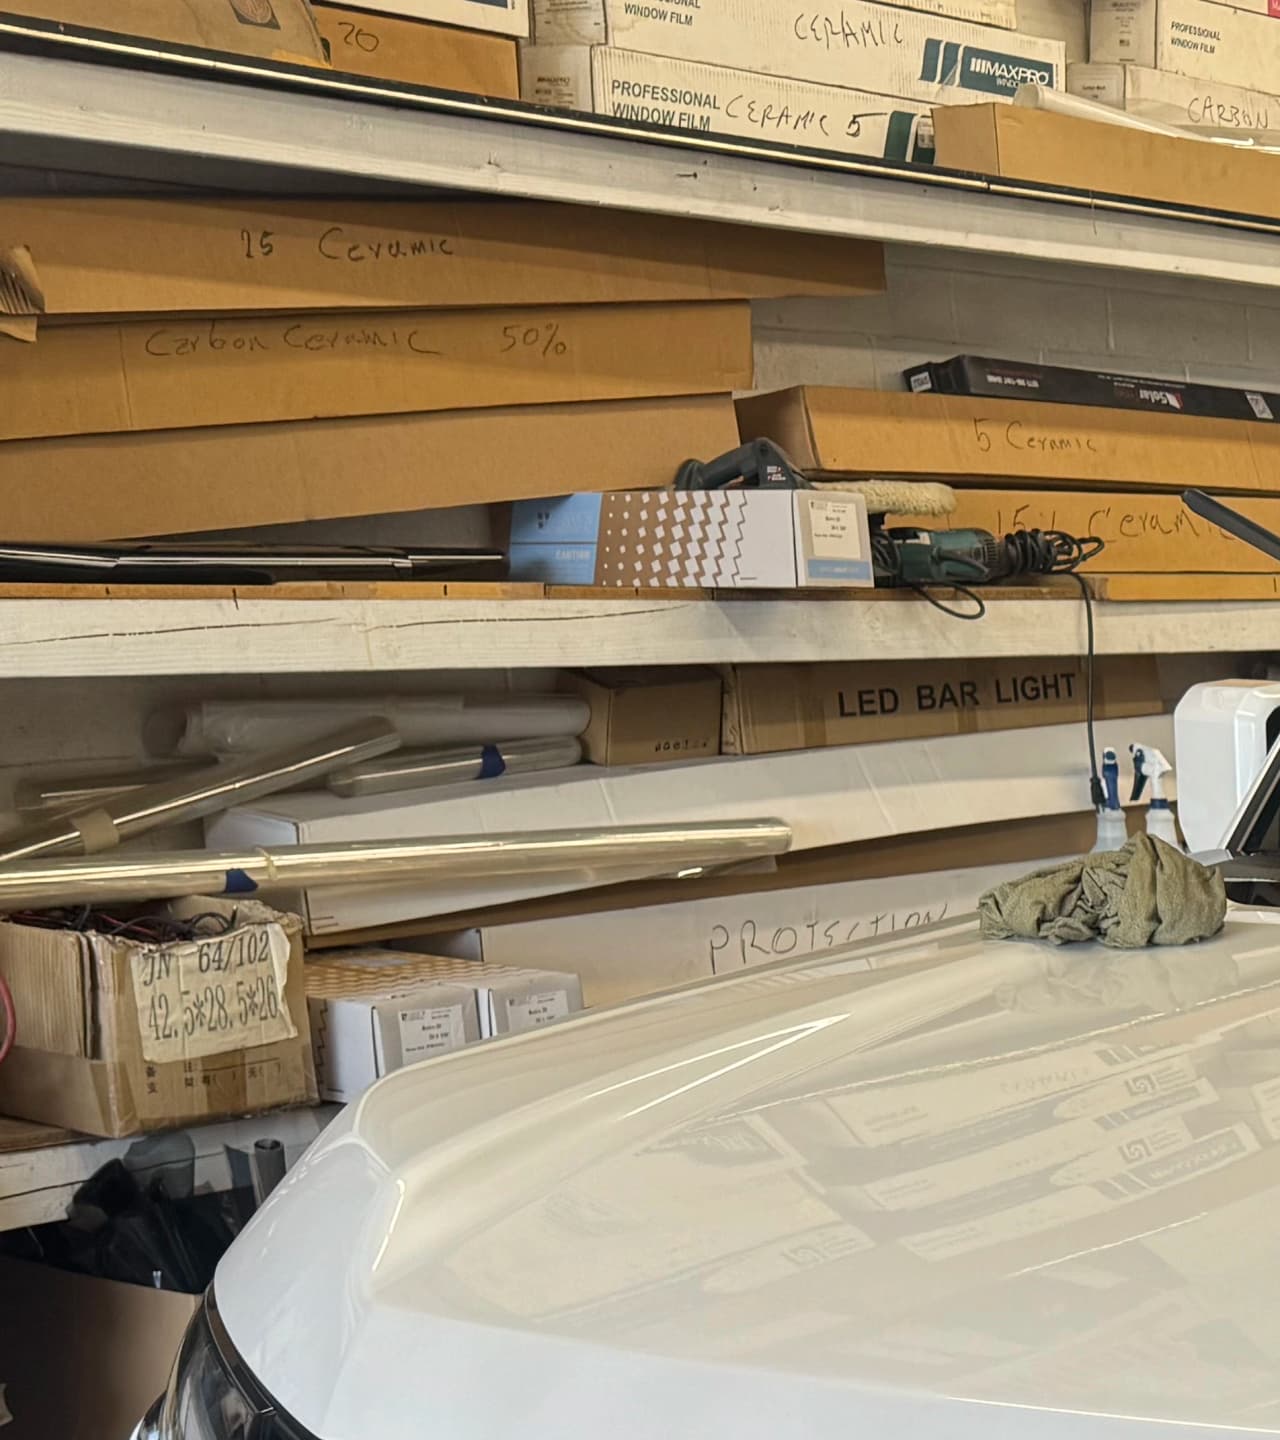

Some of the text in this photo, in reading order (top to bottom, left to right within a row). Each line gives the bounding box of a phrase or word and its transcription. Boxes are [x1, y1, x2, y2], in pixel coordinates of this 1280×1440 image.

[624, 3, 668, 22] WINDOW
[669, 11, 693, 26] FILM
[611, 79, 721, 111] PROFESSIONAL
[996, 77, 1021, 89] WINDO
[611, 102, 711, 132] WINDOW FILM
[499, 322, 568, 358] 50%
[838, 671, 1078, 719] LED BAR LIGHT
[197, 930, 270, 974] 64/102
